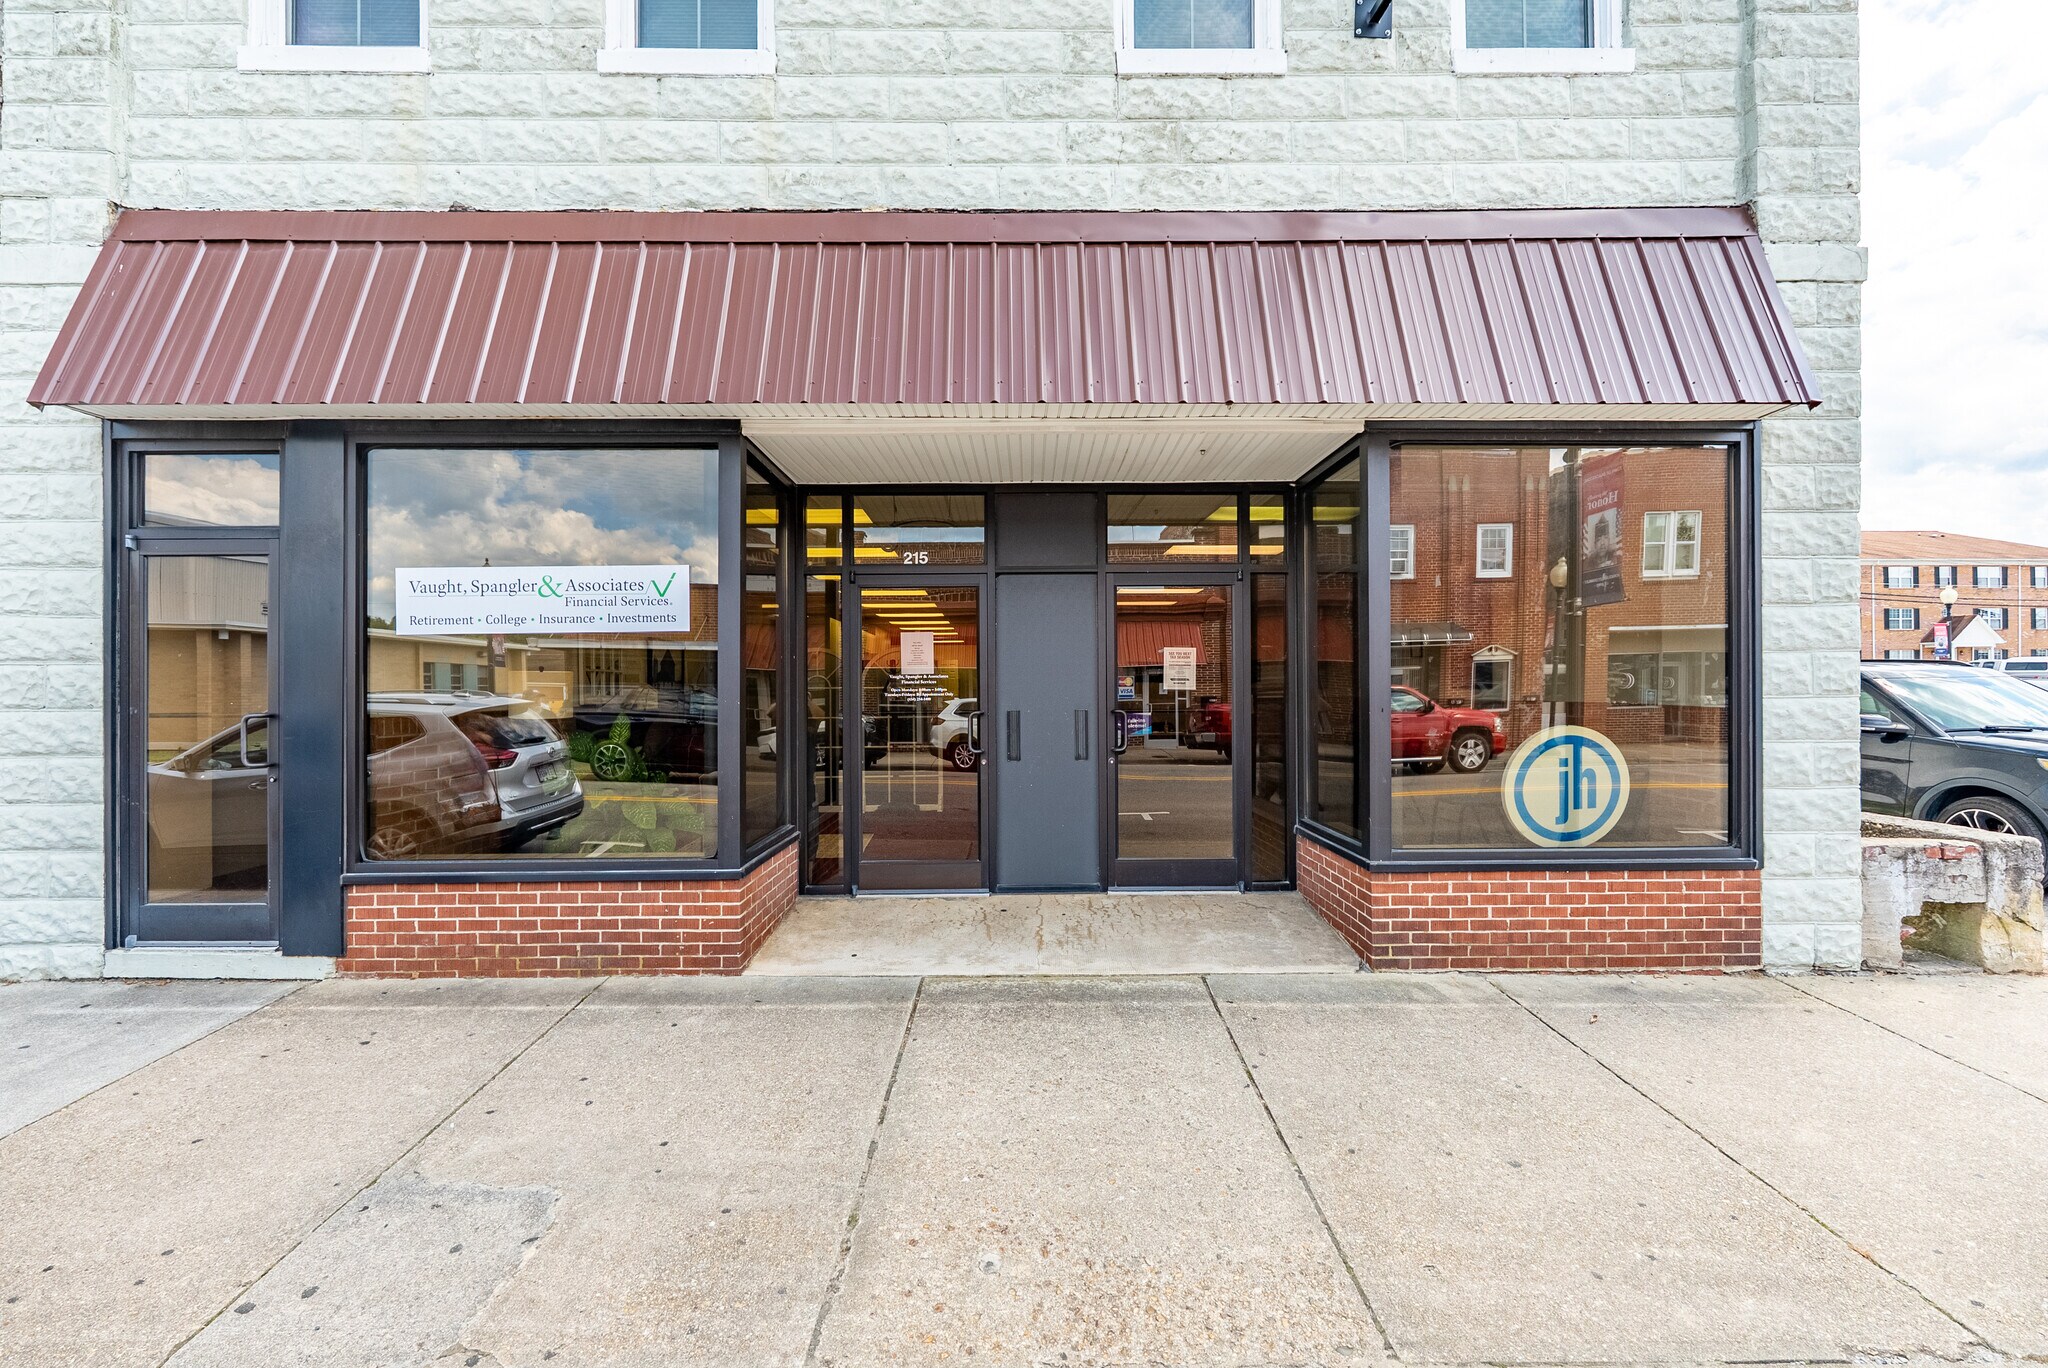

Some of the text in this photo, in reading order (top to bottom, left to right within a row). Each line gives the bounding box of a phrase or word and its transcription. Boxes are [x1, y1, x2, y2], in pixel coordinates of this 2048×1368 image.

[903, 551, 929, 565] 215
[409, 575, 644, 598] Vaught, Spangler & Associates
[565, 596, 617, 607] Financial
[409, 613, 677, 627] Retirement College Insurance Investments
